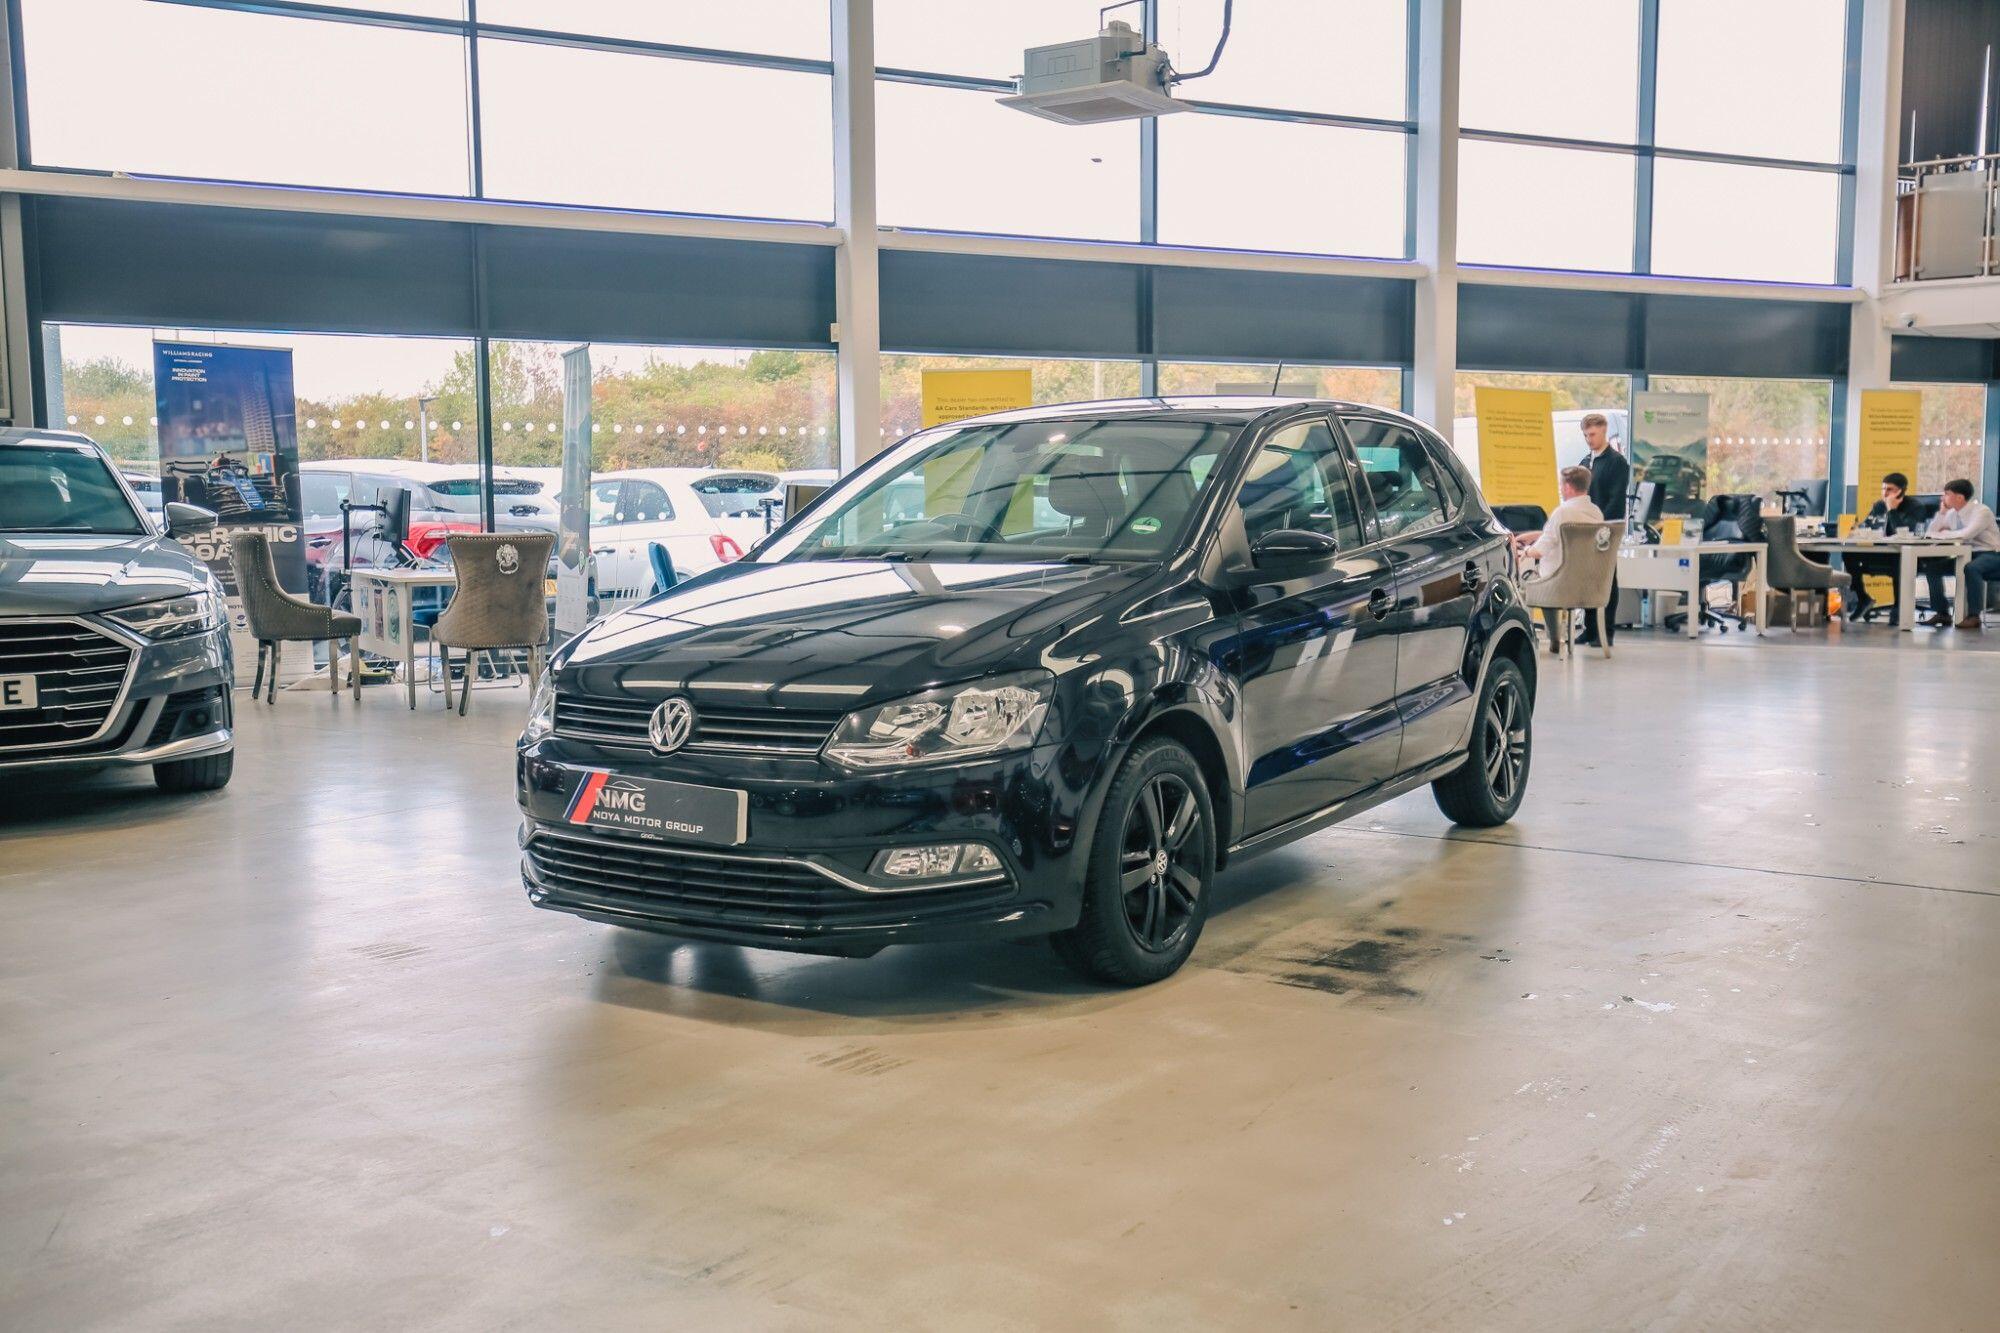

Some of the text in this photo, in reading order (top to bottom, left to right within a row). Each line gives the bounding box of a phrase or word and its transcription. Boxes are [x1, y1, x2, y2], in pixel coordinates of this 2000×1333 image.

[3, 680, 22, 705] E
[595, 787, 646, 812] NMG
[593, 811, 704, 834] NOYA MOTOR GROUP
